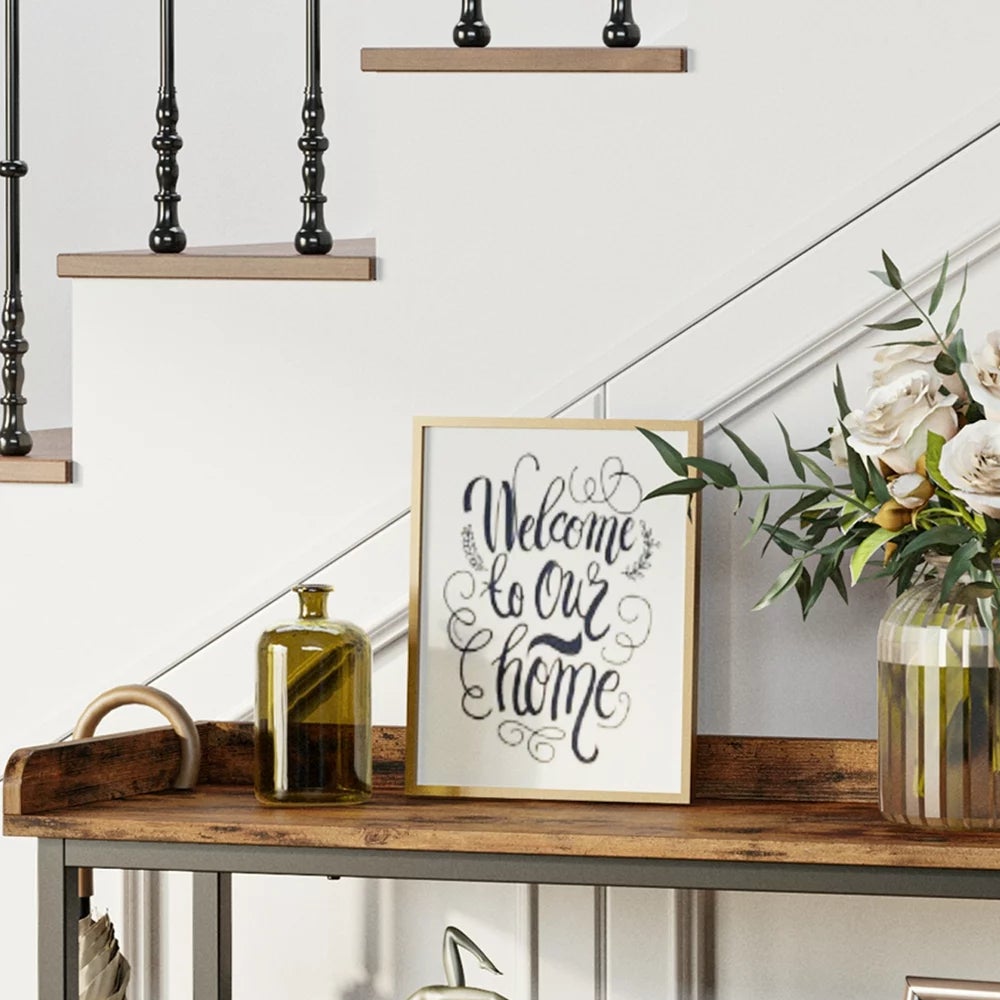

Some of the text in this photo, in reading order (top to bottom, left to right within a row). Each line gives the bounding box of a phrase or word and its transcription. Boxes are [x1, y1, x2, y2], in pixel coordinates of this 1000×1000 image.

[462, 453, 636, 565] Welcome
[480, 553, 525, 619] to
[492, 624, 622, 764] home
